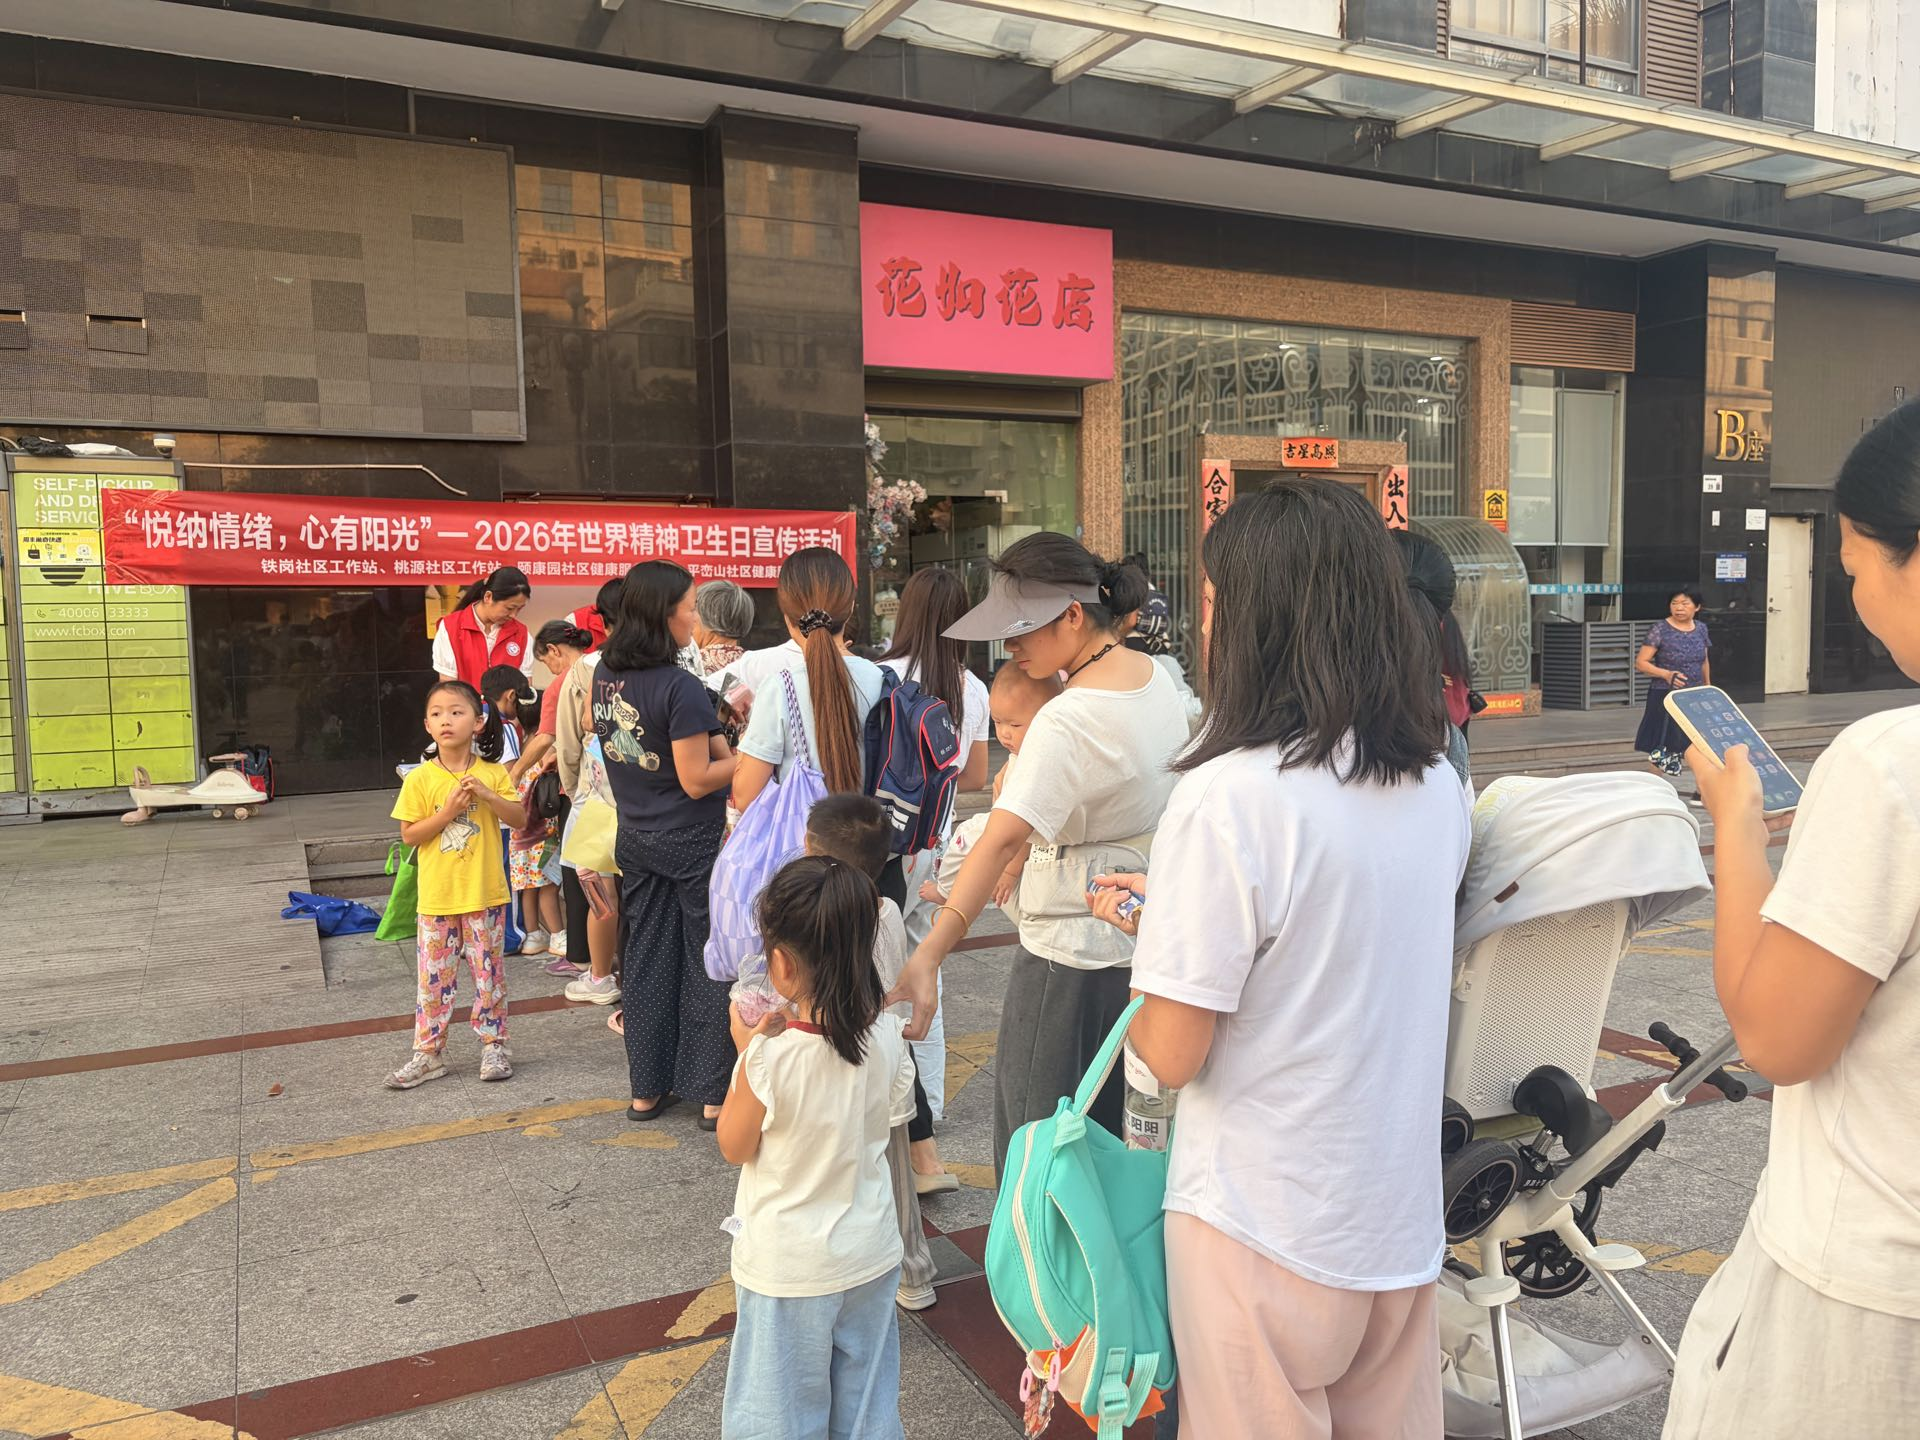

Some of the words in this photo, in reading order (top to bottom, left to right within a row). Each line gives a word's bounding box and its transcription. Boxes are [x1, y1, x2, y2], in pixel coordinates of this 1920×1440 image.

[1714, 409, 1765, 463] B座
[1283, 443, 1337, 461] 吉星高照
[34, 494, 74, 508] AND
[35, 510, 101, 525] SERVIC
